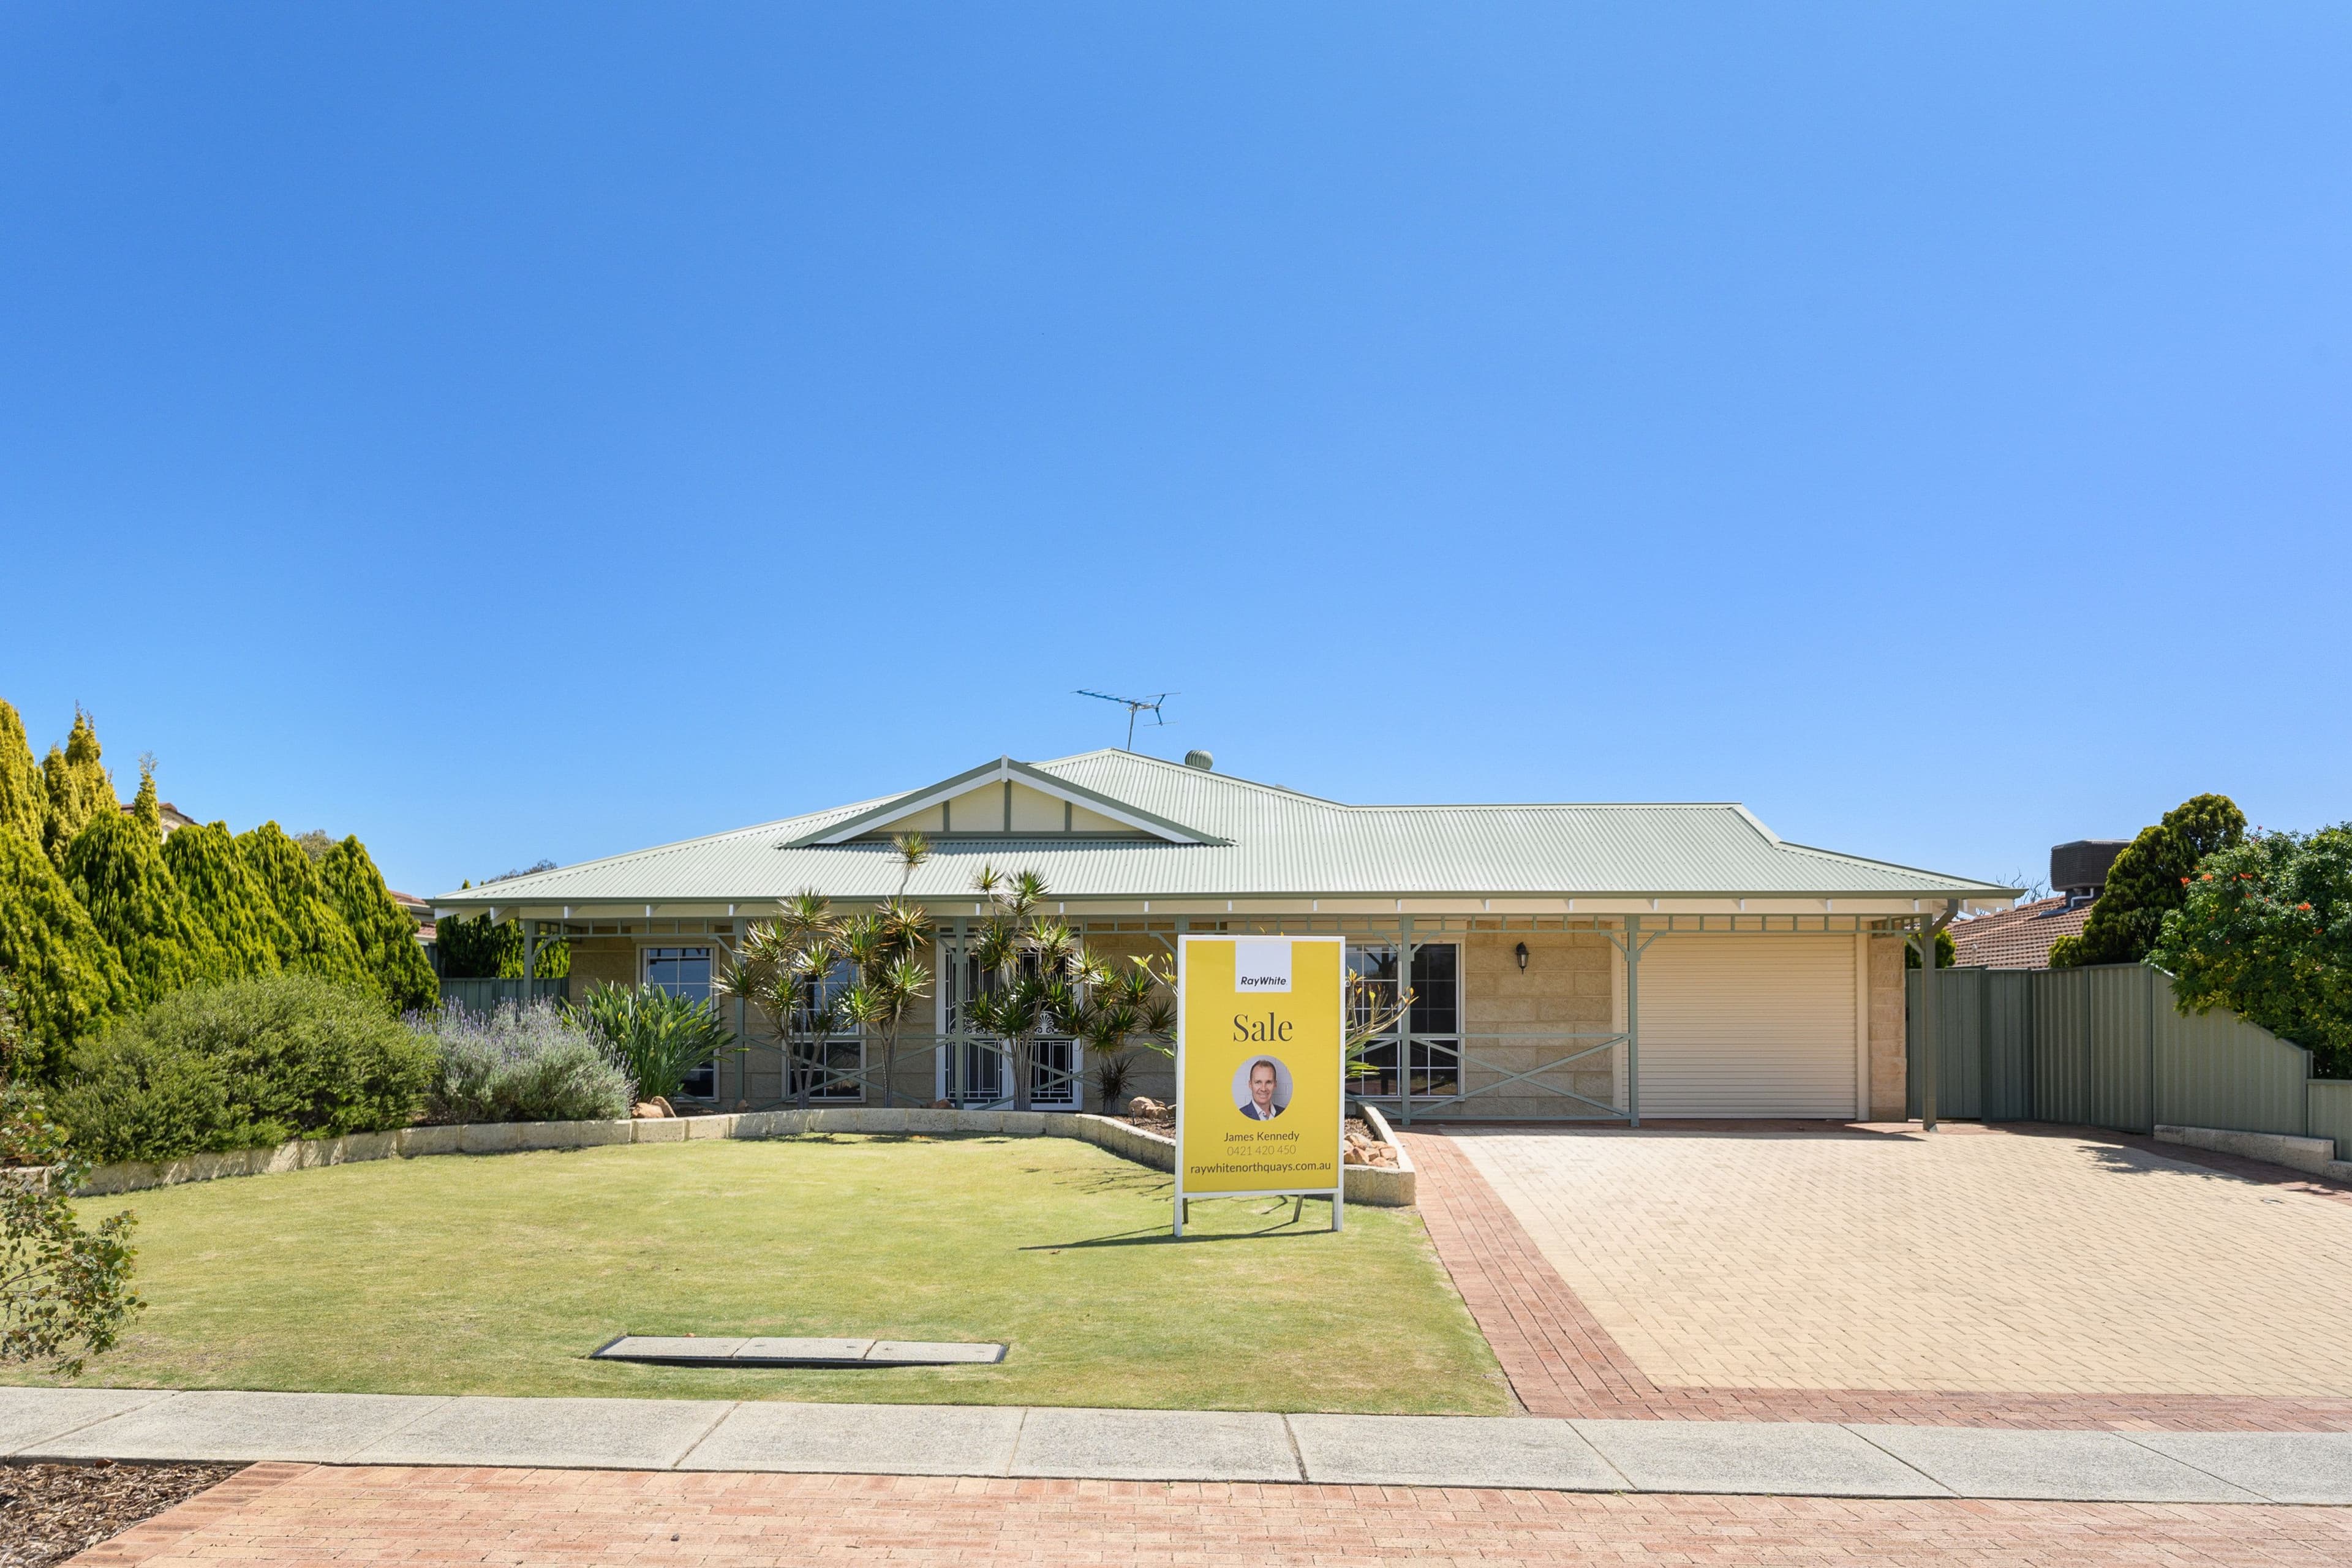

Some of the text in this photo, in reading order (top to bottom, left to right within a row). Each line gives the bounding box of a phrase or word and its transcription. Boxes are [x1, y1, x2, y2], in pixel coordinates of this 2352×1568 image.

[1233, 1011, 1293, 1042] Sale
[1224, 1131, 1300, 1142] James Kennedy
[1227, 1144, 1297, 1156] 0421 420 450
[1190, 1161, 1331, 1176] raywhitenorthquays.com.au
